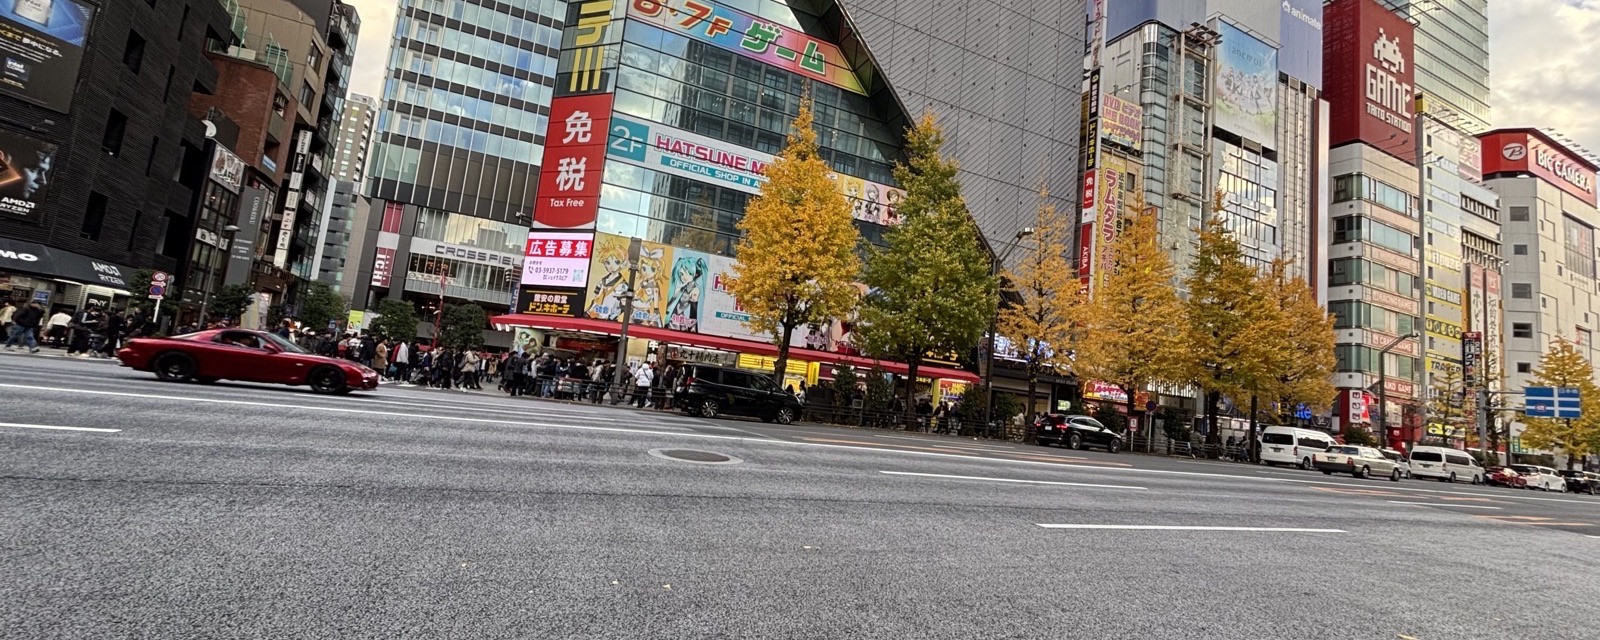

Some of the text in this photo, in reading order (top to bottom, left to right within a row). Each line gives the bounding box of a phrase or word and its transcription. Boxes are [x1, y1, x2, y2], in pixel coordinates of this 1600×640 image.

[1291, 7, 1321, 30] animate
[740, 20, 826, 76] ゲーム
[1366, 63, 1411, 120] GAME
[1366, 102, 1385, 121] TAITO
[556, 110, 592, 191] 免税
[611, 125, 645, 155] 2F
[655, 134, 747, 173] HATSUNE
[669, 159, 711, 176] OFFICIAL
[714, 169, 740, 185] SHOP
[741, 178, 754, 188] IN
[1553, 159, 1591, 194] CAMERA
[551, 197, 585, 208] Tax Free
[1103, 169, 1117, 243] ラムタラ
[529, 240, 588, 257] 広告募集
[92, 262, 118, 276] AMD
[88, 298, 107, 307] PNY
[534, 294, 568, 304] 驚安の殿堂
